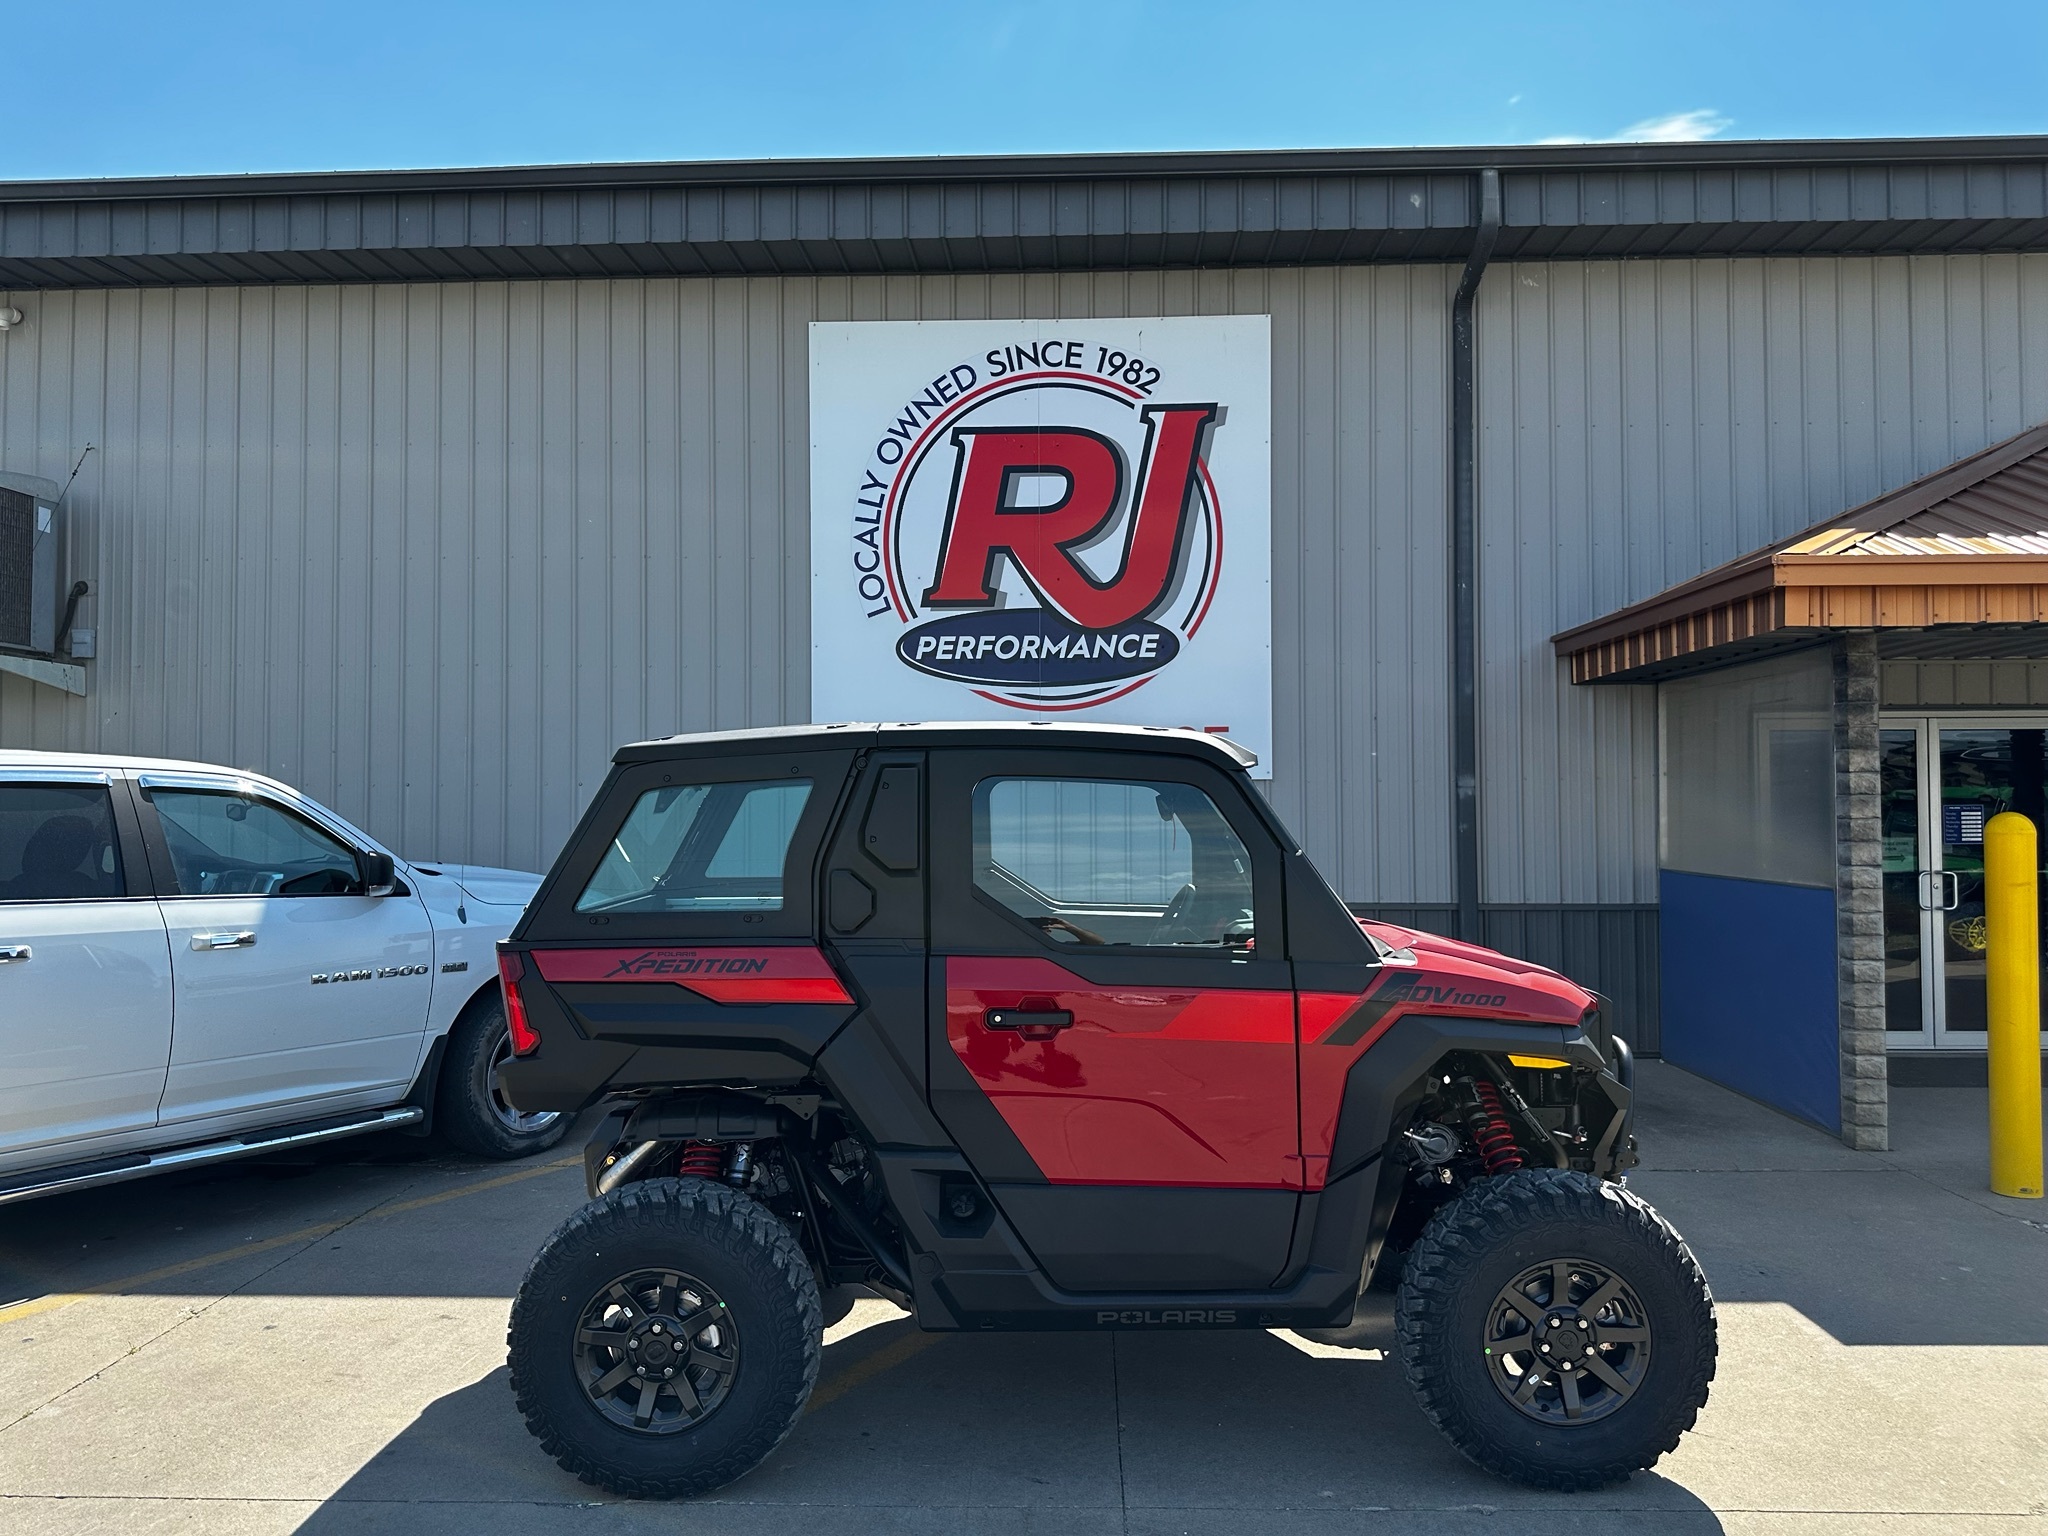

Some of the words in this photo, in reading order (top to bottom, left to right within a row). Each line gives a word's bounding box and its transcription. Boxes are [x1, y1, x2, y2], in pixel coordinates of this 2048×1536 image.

[854, 470, 893, 618] LOCALLY
[877, 364, 977, 465] OWNED
[986, 341, 1085, 377] SINCE
[1097, 347, 1161, 395] 1982
[920, 402, 1220, 634] RJ
[915, 633, 1161, 661] PERFORMANCE
[311, 969, 372, 985] RAM
[377, 964, 429, 979] 1500
[602, 952, 769, 978] XPEDITION
[1097, 1310, 1237, 1324] POLARIS
